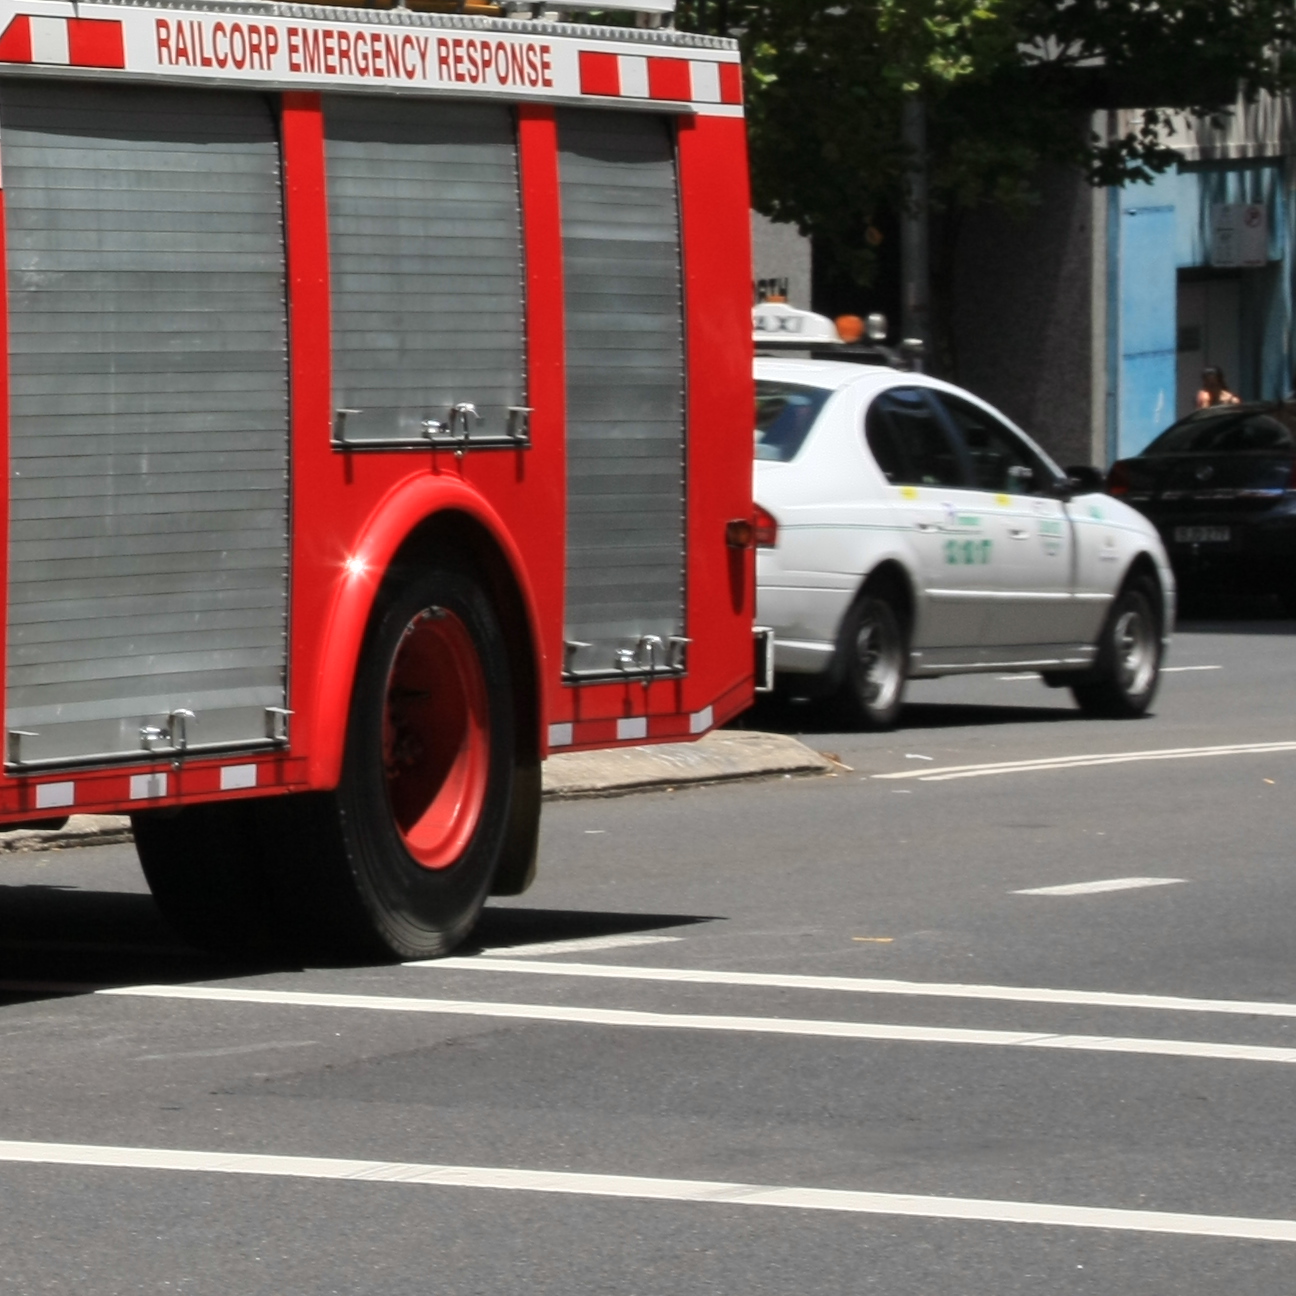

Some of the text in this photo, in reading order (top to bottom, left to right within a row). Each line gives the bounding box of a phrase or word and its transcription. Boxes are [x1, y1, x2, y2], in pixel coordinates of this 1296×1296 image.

[155, 16, 555, 89] RAILCORP EMERGENCY RESPONSE
